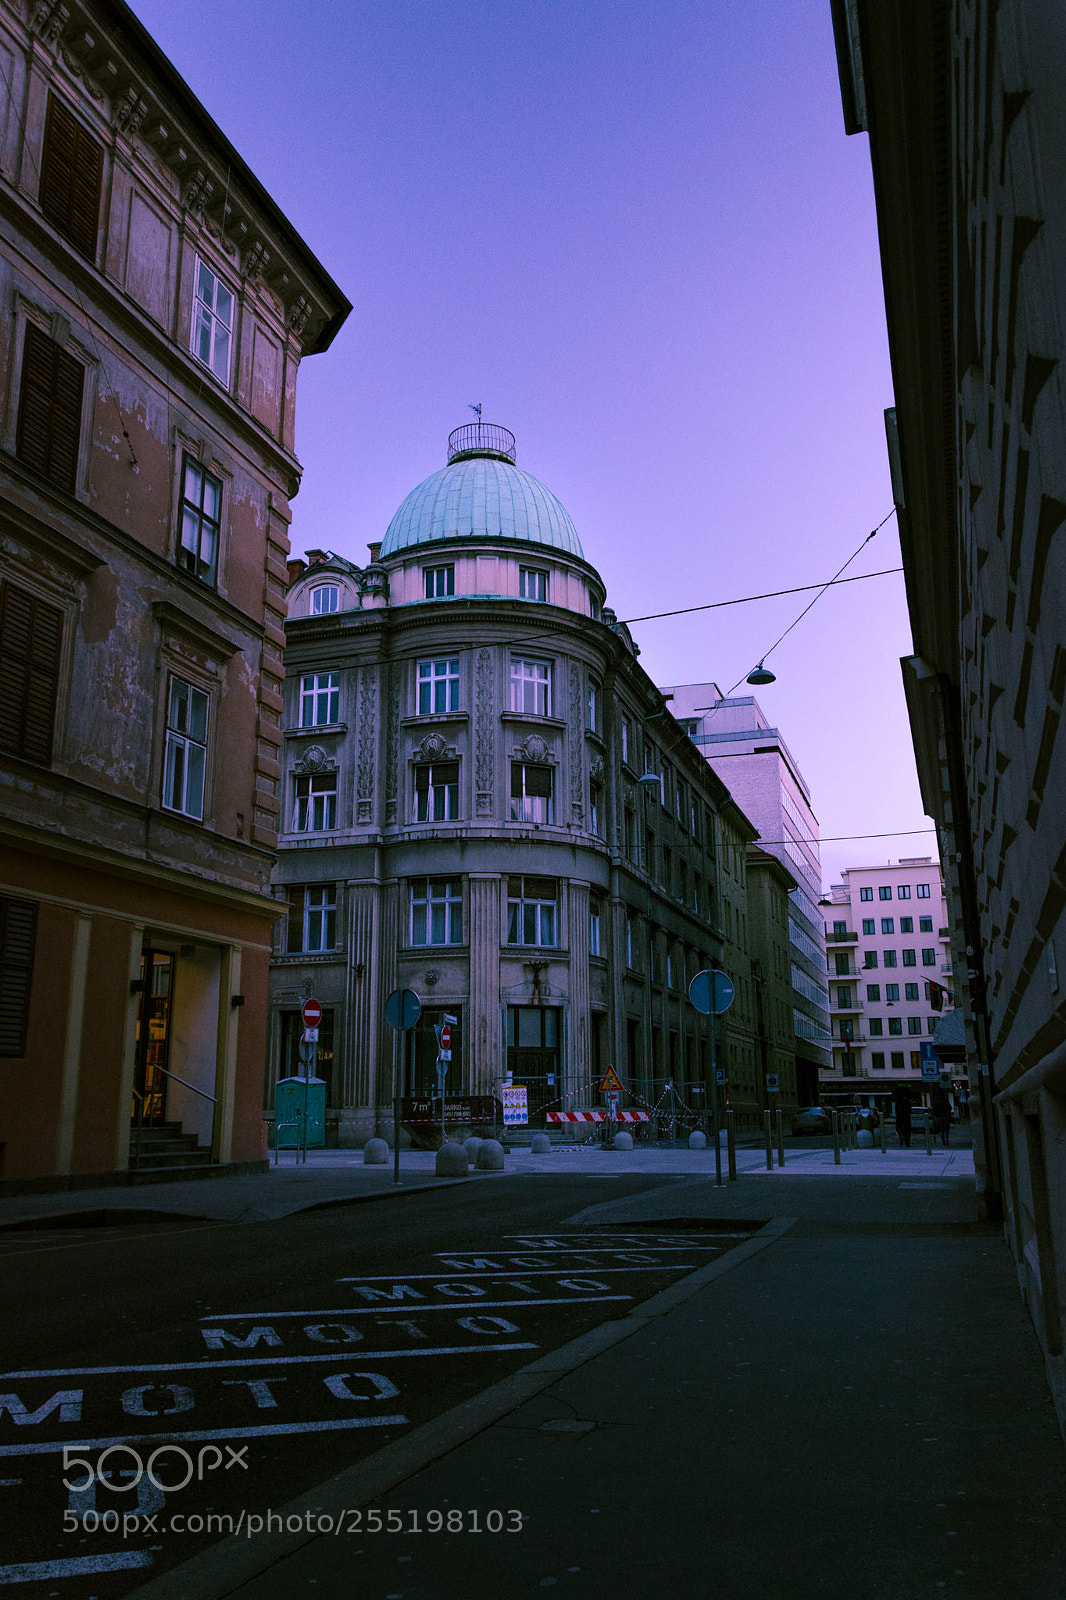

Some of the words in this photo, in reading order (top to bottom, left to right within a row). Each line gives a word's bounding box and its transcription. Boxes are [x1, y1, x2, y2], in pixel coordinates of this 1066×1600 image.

[412, 1102, 418, 1113] 7
[514, 1236, 703, 1249] MOTO
[438, 1252, 663, 1271] MOTO
[352, 1277, 612, 1301] MOTO
[200, 1314, 521, 1350] MOTO
[0, 1371, 401, 1425] MOTO
